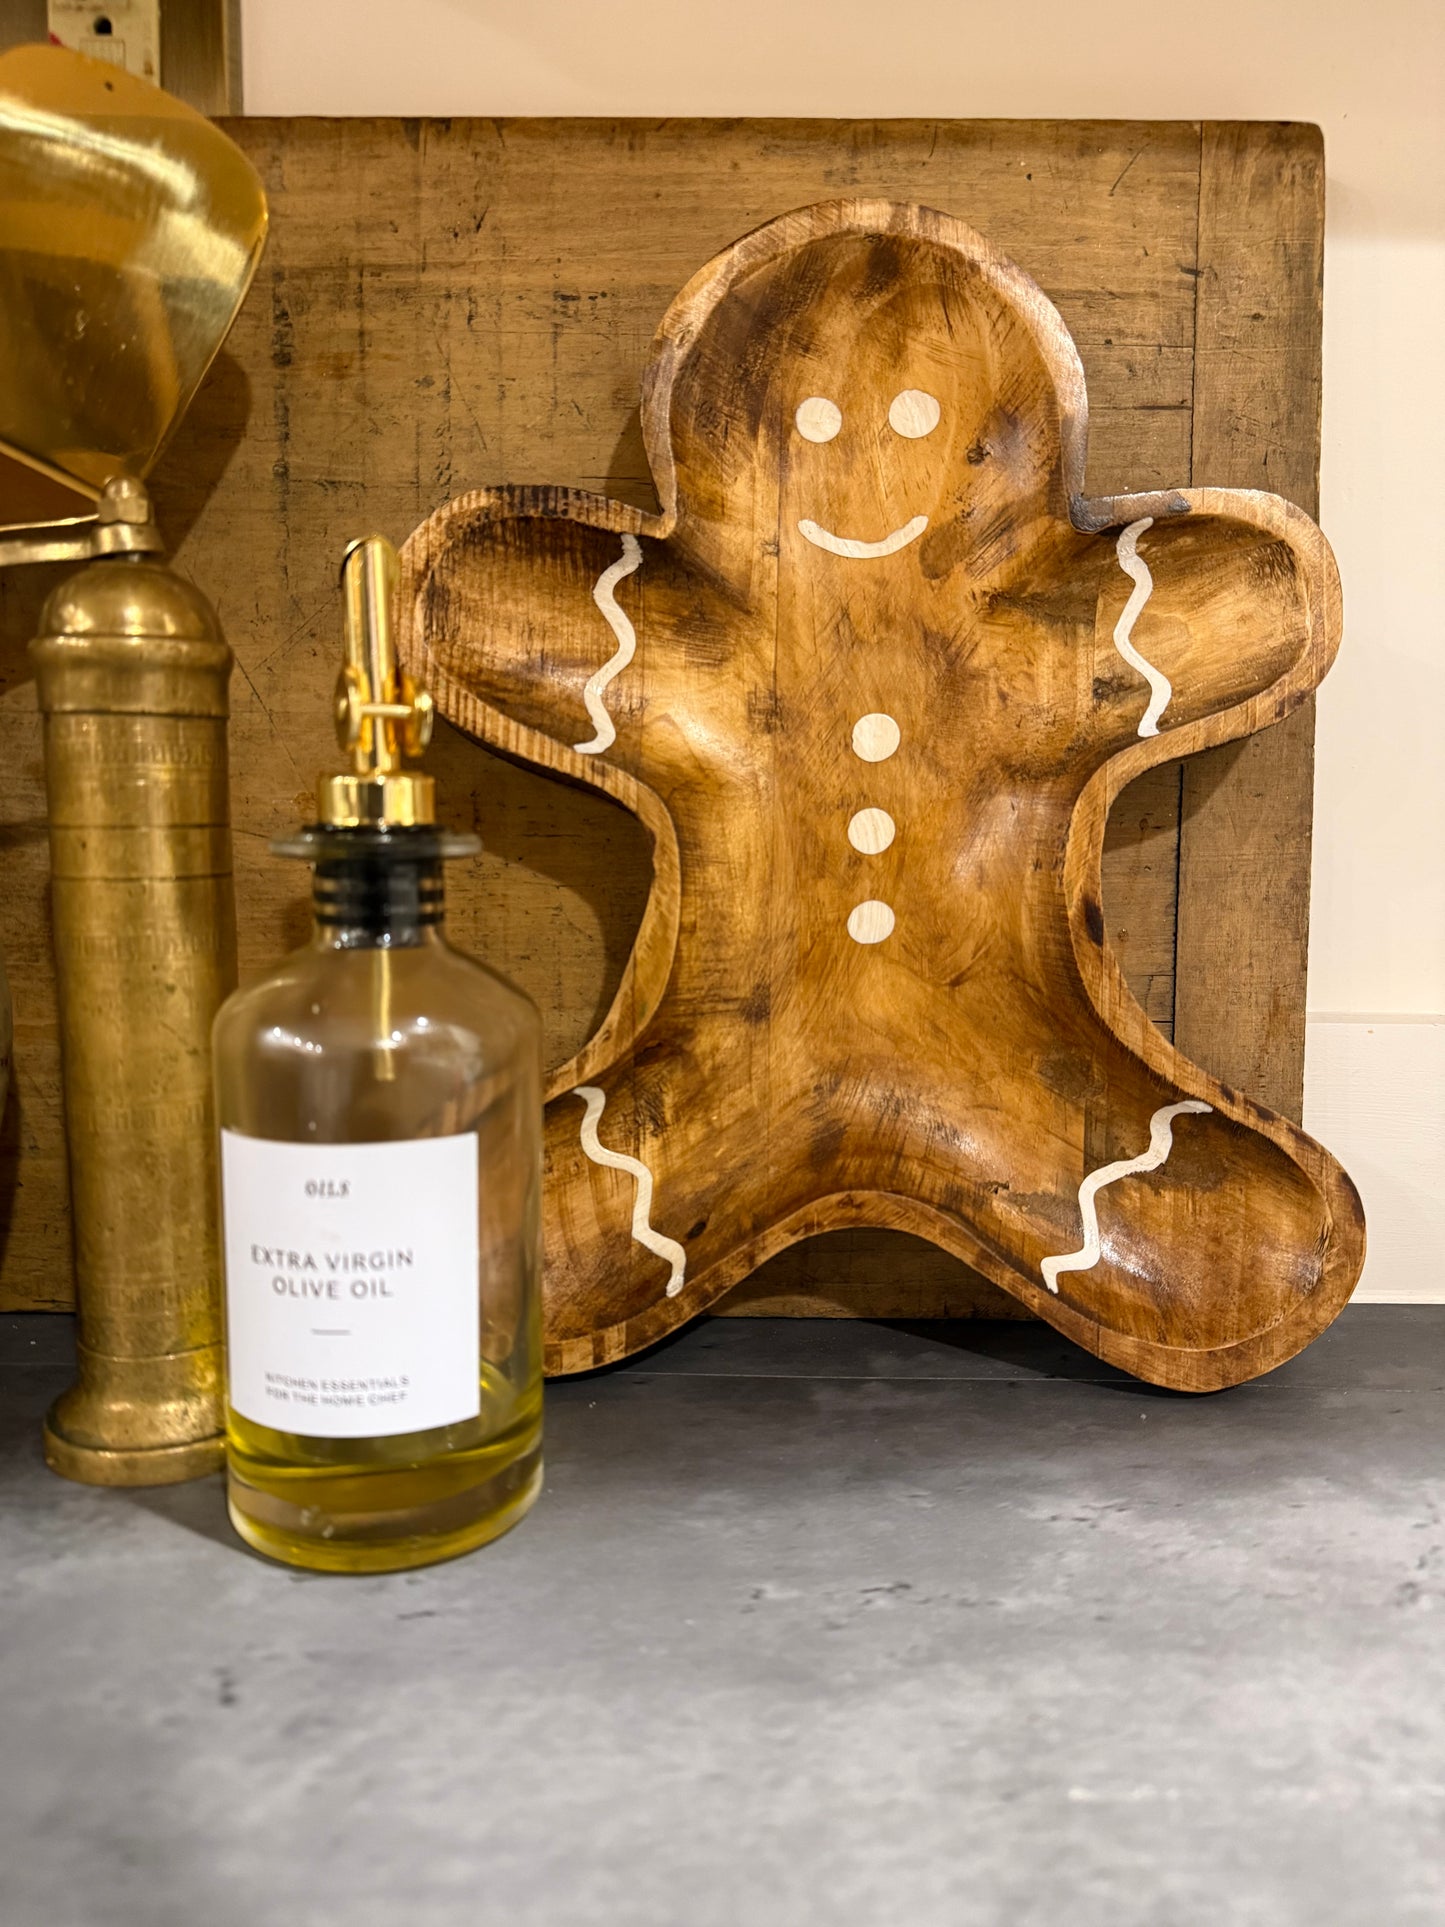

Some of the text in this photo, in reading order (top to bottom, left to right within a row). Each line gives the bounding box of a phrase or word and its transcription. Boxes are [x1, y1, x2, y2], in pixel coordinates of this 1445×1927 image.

[305, 1178, 351, 1199] OILS
[251, 1244, 413, 1272] EXTRA VIRGIN
[272, 1275, 393, 1300] OLIVE OIL
[321, 1374, 410, 1391] ESSENTIALS
[292, 1390, 319, 1405] THE
